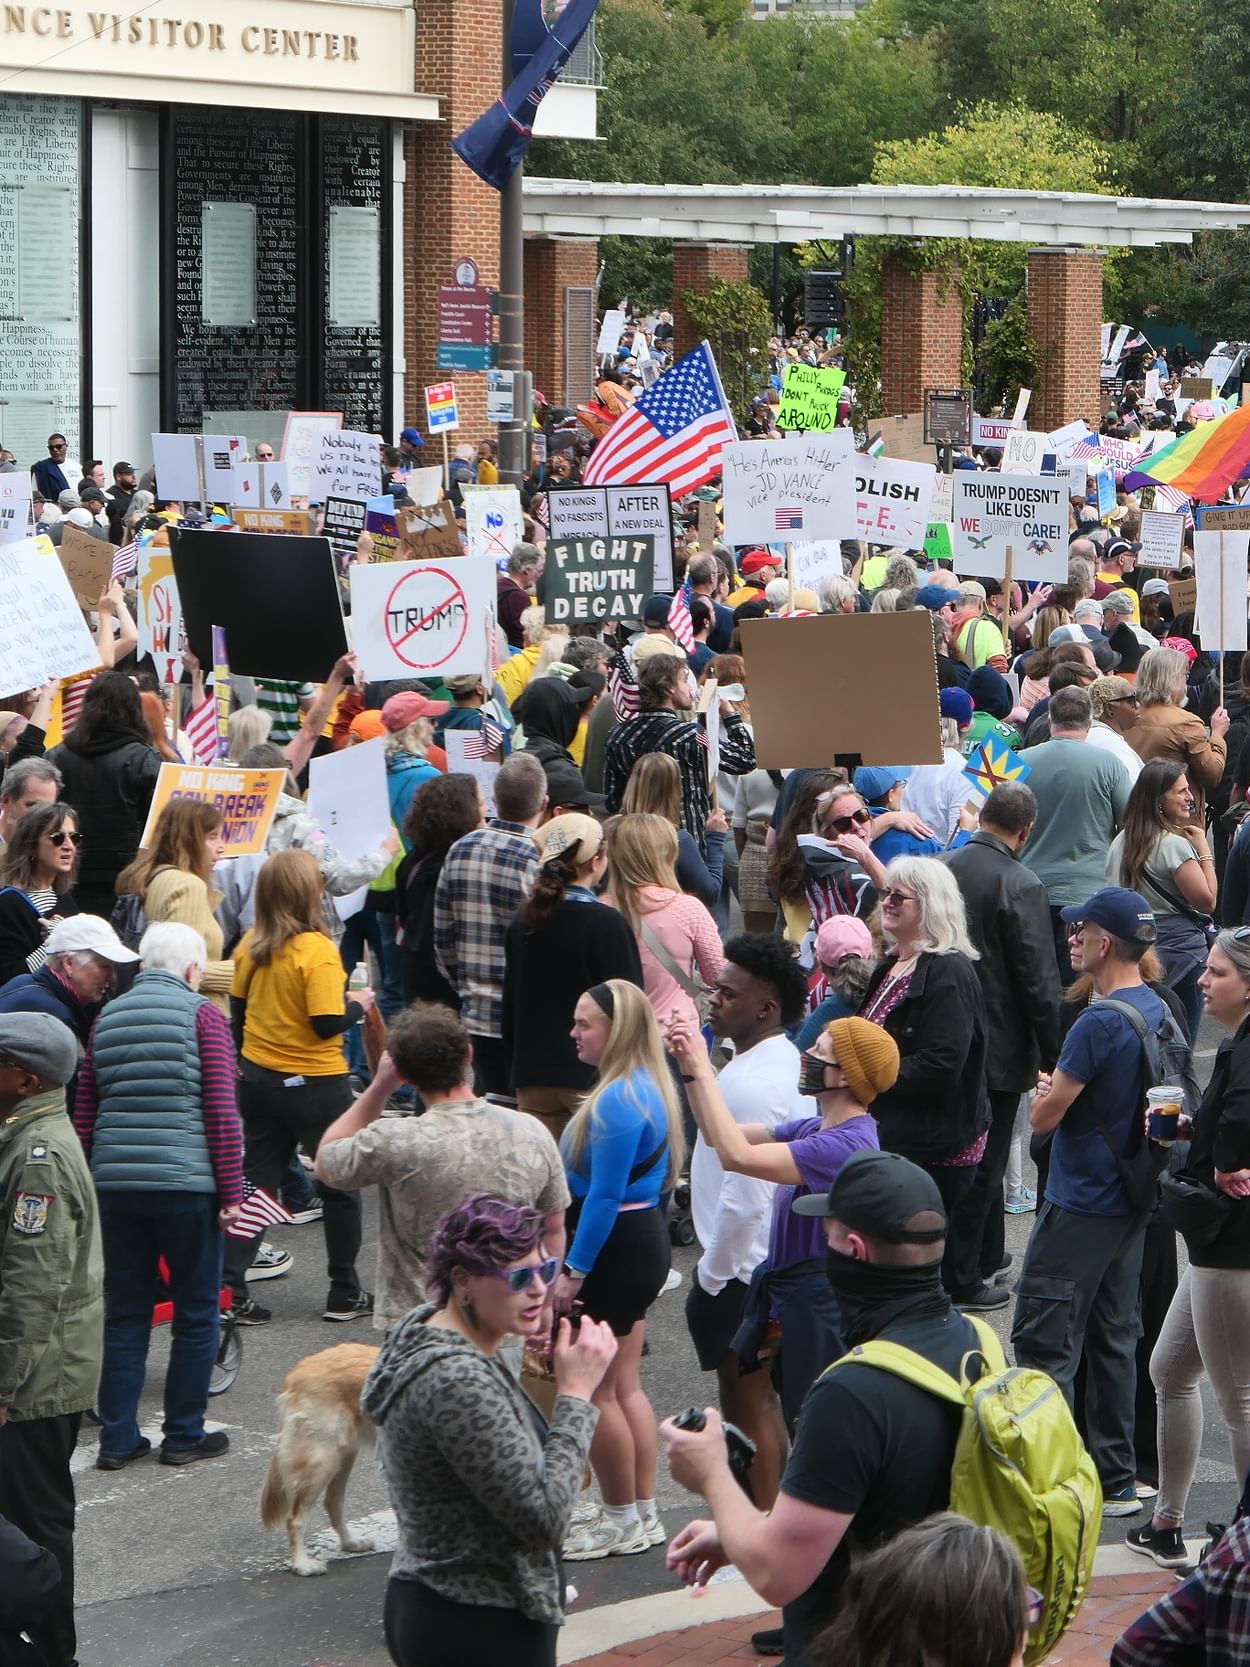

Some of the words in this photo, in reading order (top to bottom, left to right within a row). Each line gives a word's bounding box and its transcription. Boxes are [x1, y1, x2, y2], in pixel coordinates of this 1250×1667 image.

[87, 12, 227, 50] VISITOR
[241, 25, 360, 62] CENTER
[23, 113, 55, 125] Creator
[59, 116, 77, 126] with
[20, 160, 42, 171] these
[7, 335, 39, 346] Course
[29, 358, 61, 368] dissolve
[26, 369, 52, 380] which
[20, 379, 39, 391] with
[776, 408, 832, 430] AROUND
[980, 425, 994, 438] NO
[1103, 437, 1124, 451] WHO
[783, 473, 825, 490] VANCE
[855, 477, 920, 502] OLISH
[559, 498, 571, 507] NO
[572, 496, 597, 506] KINGS
[778, 490, 832, 507] president
[962, 483, 1006, 500] TRUMP
[1009, 487, 1060, 504] DOESN'T
[617, 496, 660, 512] AFTER
[986, 501, 1012, 517] LIKE
[1014, 503, 1035, 519] US!
[486, 512, 504, 528] NO
[553, 513, 567, 523] NO
[568, 512, 604, 522] FASCISTS
[614, 521, 621, 529] A
[622, 520, 642, 529] NEW
[643, 519, 665, 528] DEAL
[1205, 511, 1227, 523] GIVE
[960, 517, 980, 533] WE
[982, 518, 1021, 536] DON'T
[1023, 522, 1061, 540] CARE!
[554, 540, 648, 568] FIGHT
[565, 568, 636, 593] TRUTH
[554, 593, 644, 619] DECAY
[388, 604, 467, 633] TRUMP
[179, 770, 204, 789] NO
[214, 794, 268, 818] BREAK
[221, 820, 259, 844] NION
